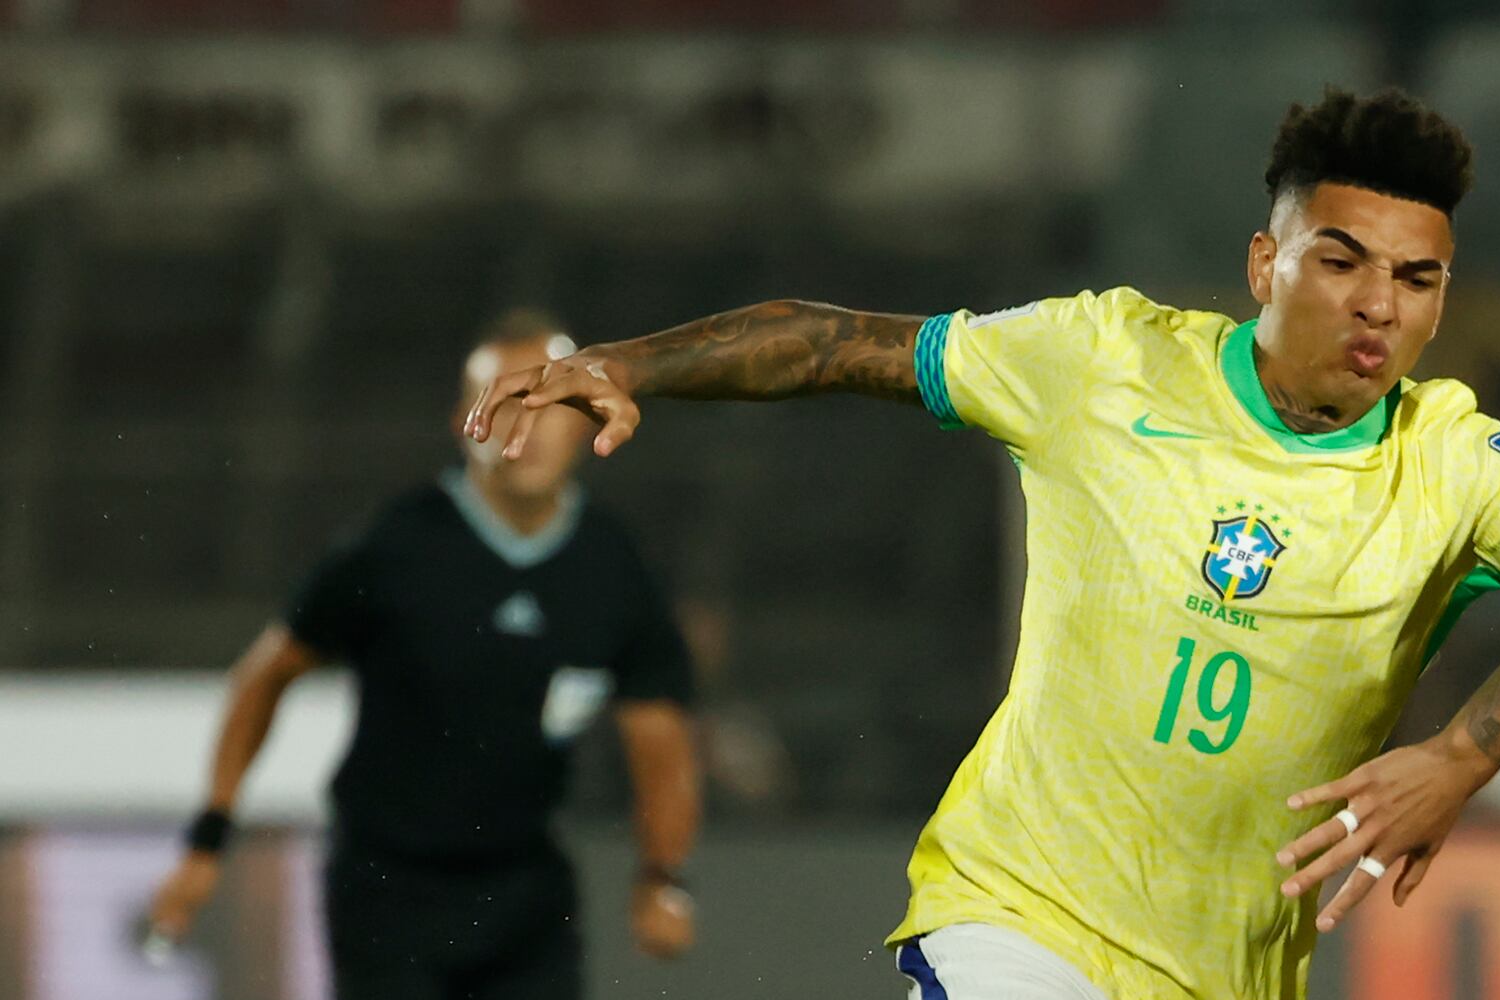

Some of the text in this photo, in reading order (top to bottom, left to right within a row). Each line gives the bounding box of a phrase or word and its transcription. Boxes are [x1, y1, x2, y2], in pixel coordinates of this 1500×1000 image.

[1228, 547, 1255, 563] CBF
[1186, 594, 1259, 631] BRASIL
[1153, 636, 1252, 754] 19
